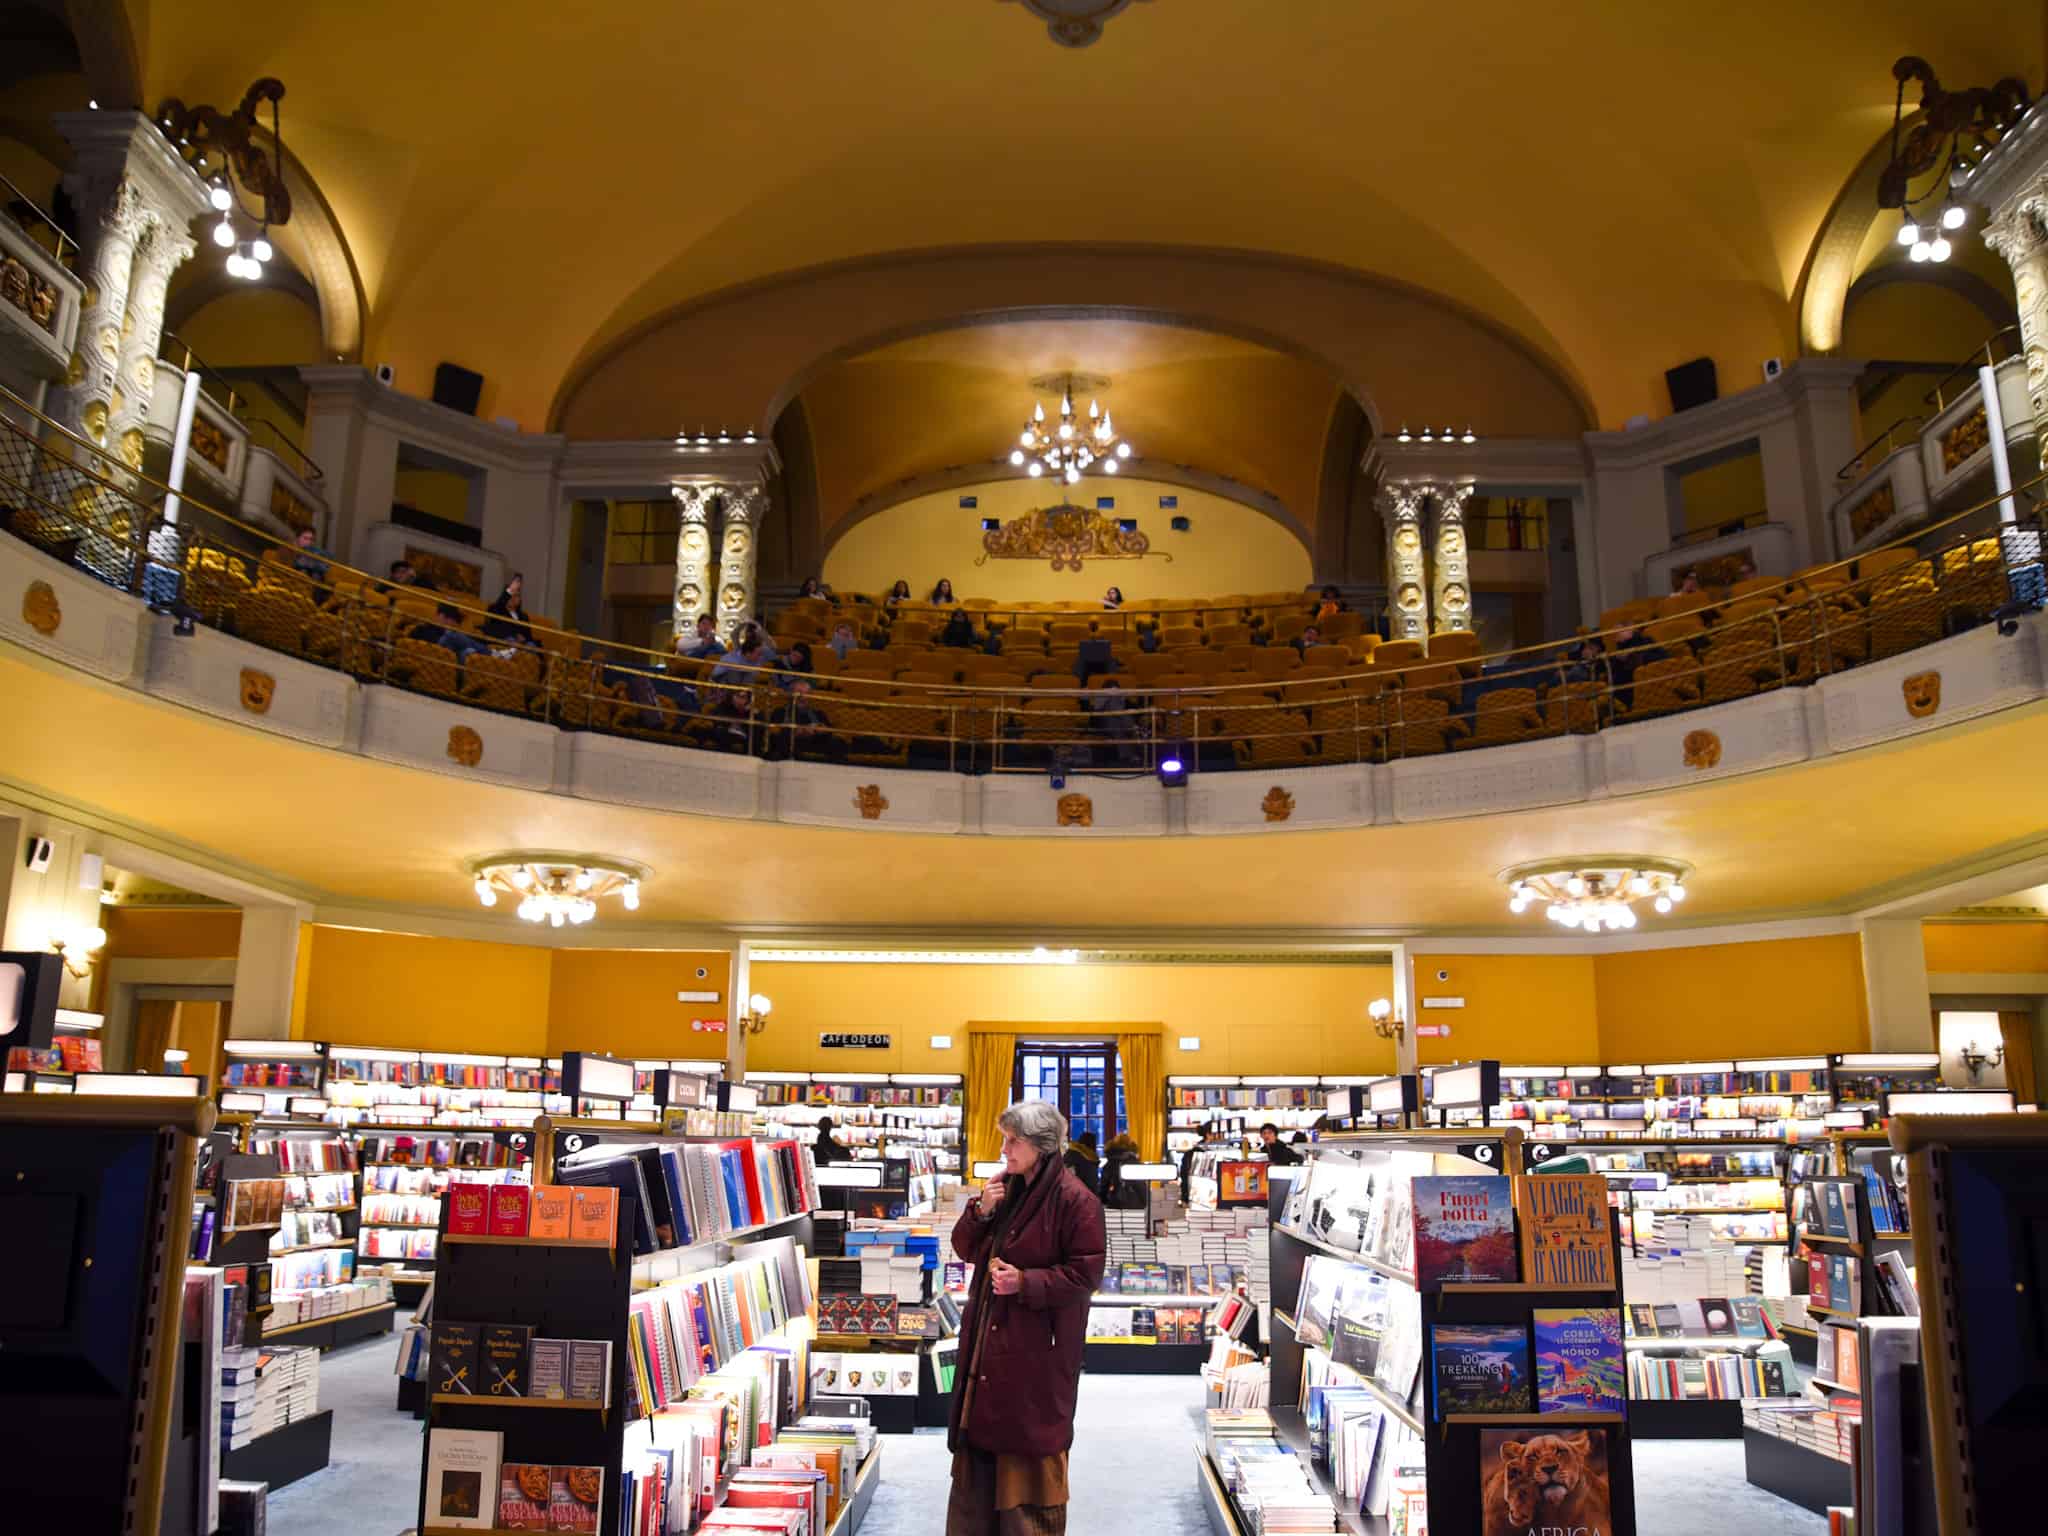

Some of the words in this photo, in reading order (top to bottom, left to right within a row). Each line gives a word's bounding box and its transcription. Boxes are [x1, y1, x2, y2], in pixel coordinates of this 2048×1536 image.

[850, 1035, 888, 1045] ODEON
[1440, 1191, 1488, 1206] Fuori
[1528, 1182, 1585, 1215] VIAGGI
[1441, 1207, 1488, 1221] rotta
[1561, 1348, 1600, 1356] MONDO
[1461, 1354, 1480, 1365] 100
[1441, 1365, 1500, 1375] TREKKING
